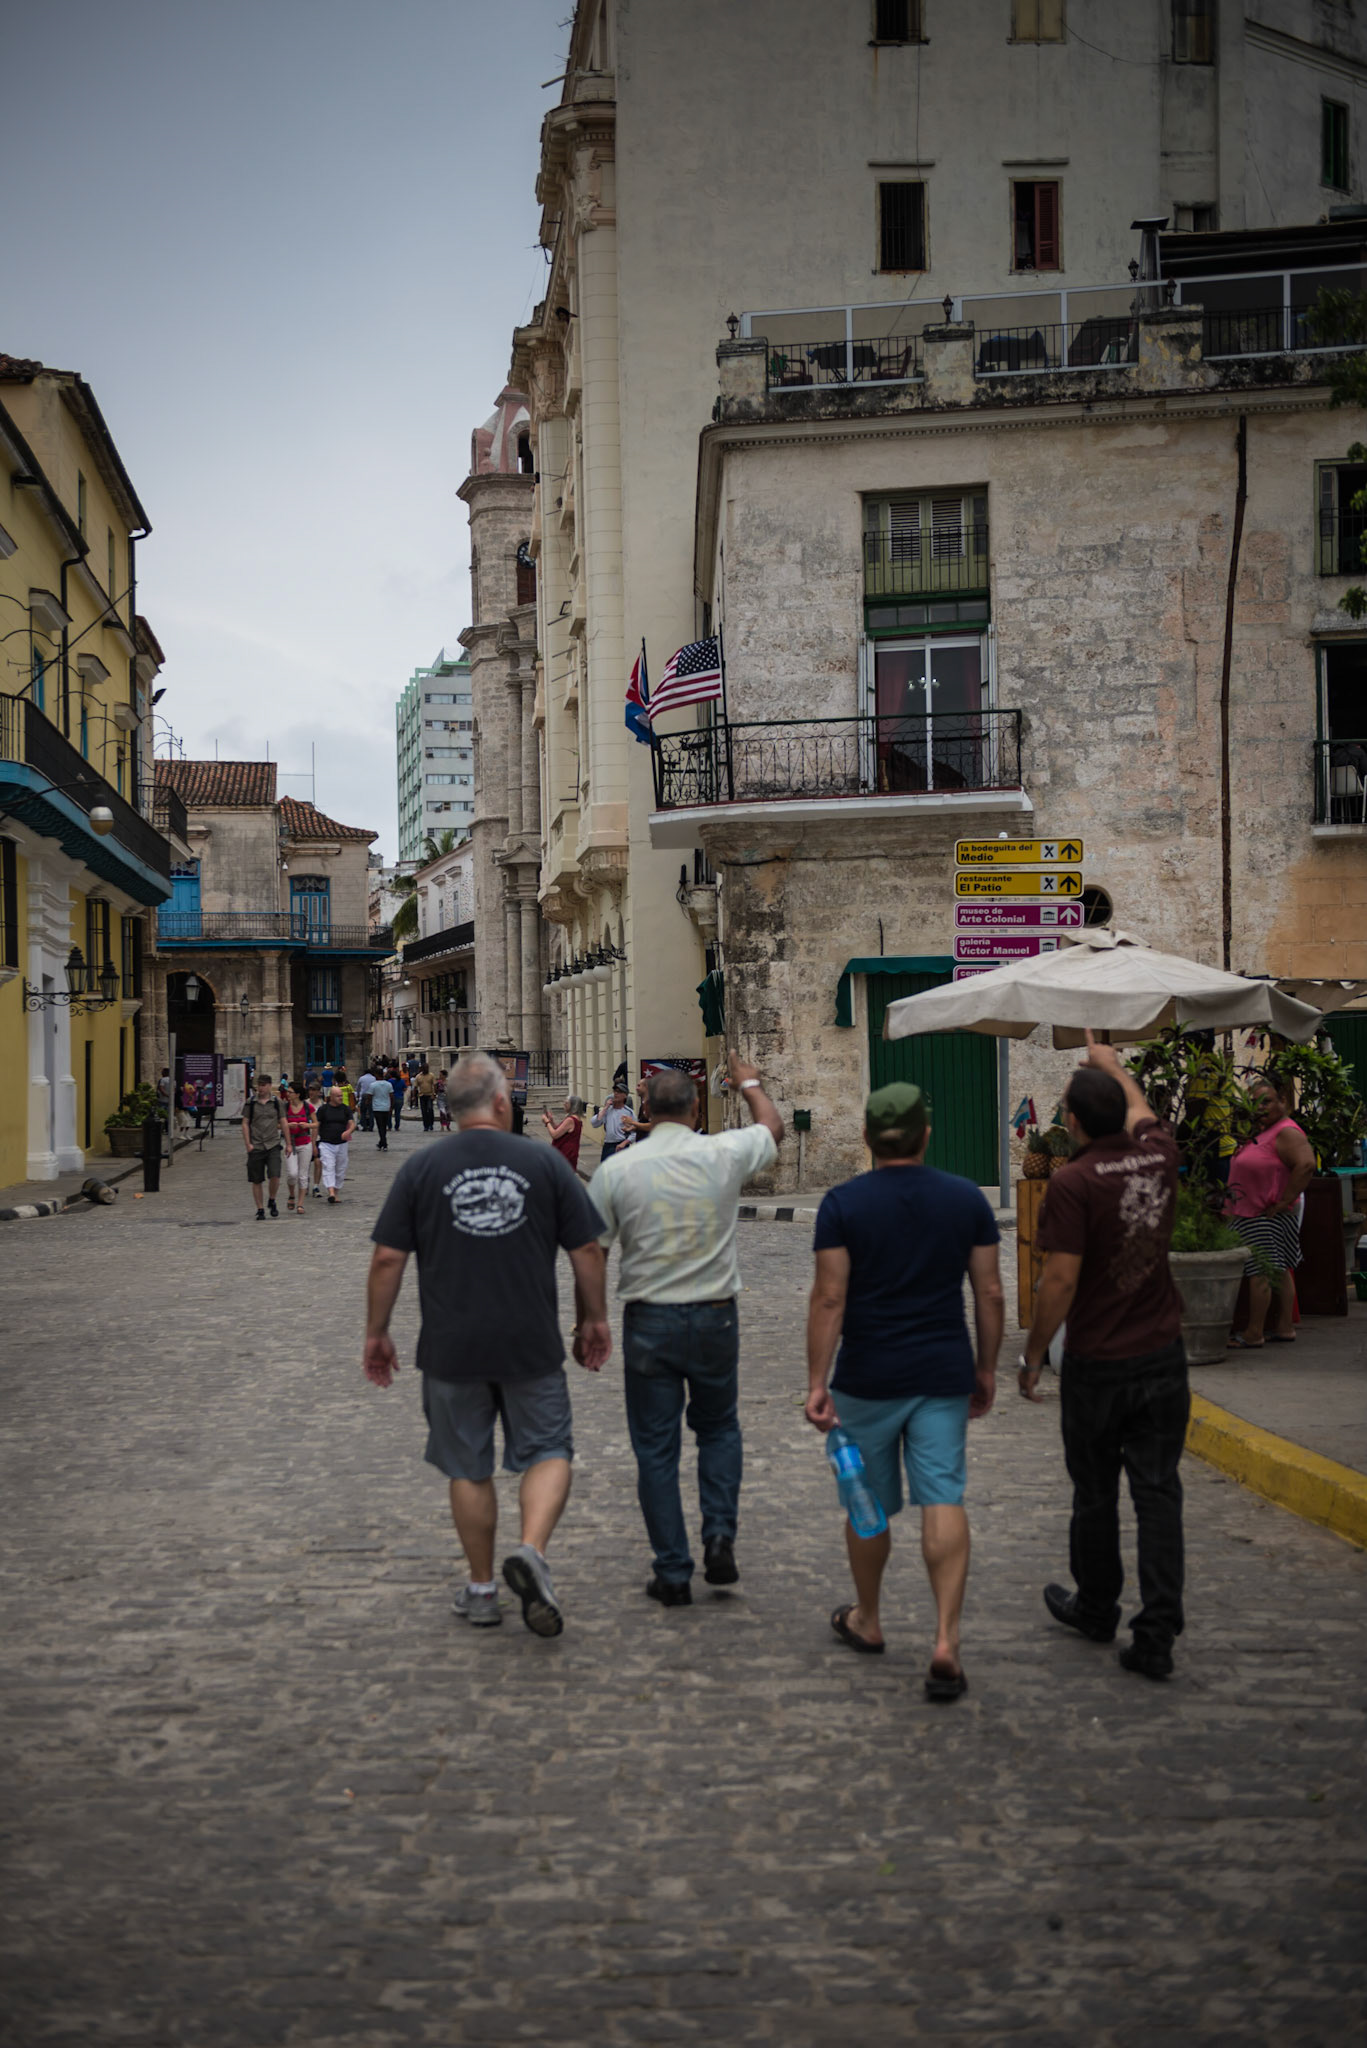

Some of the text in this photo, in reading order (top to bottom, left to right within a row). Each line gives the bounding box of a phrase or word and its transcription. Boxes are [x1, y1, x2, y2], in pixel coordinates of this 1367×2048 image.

[971, 844, 1016, 853] bodeguita
[960, 853, 994, 861] Medio
[973, 883, 1002, 891] Patio
[959, 915, 1026, 923] Arte Colonial
[992, 946, 1030, 955] Manuel
[463, 1166, 498, 1179] Spring
